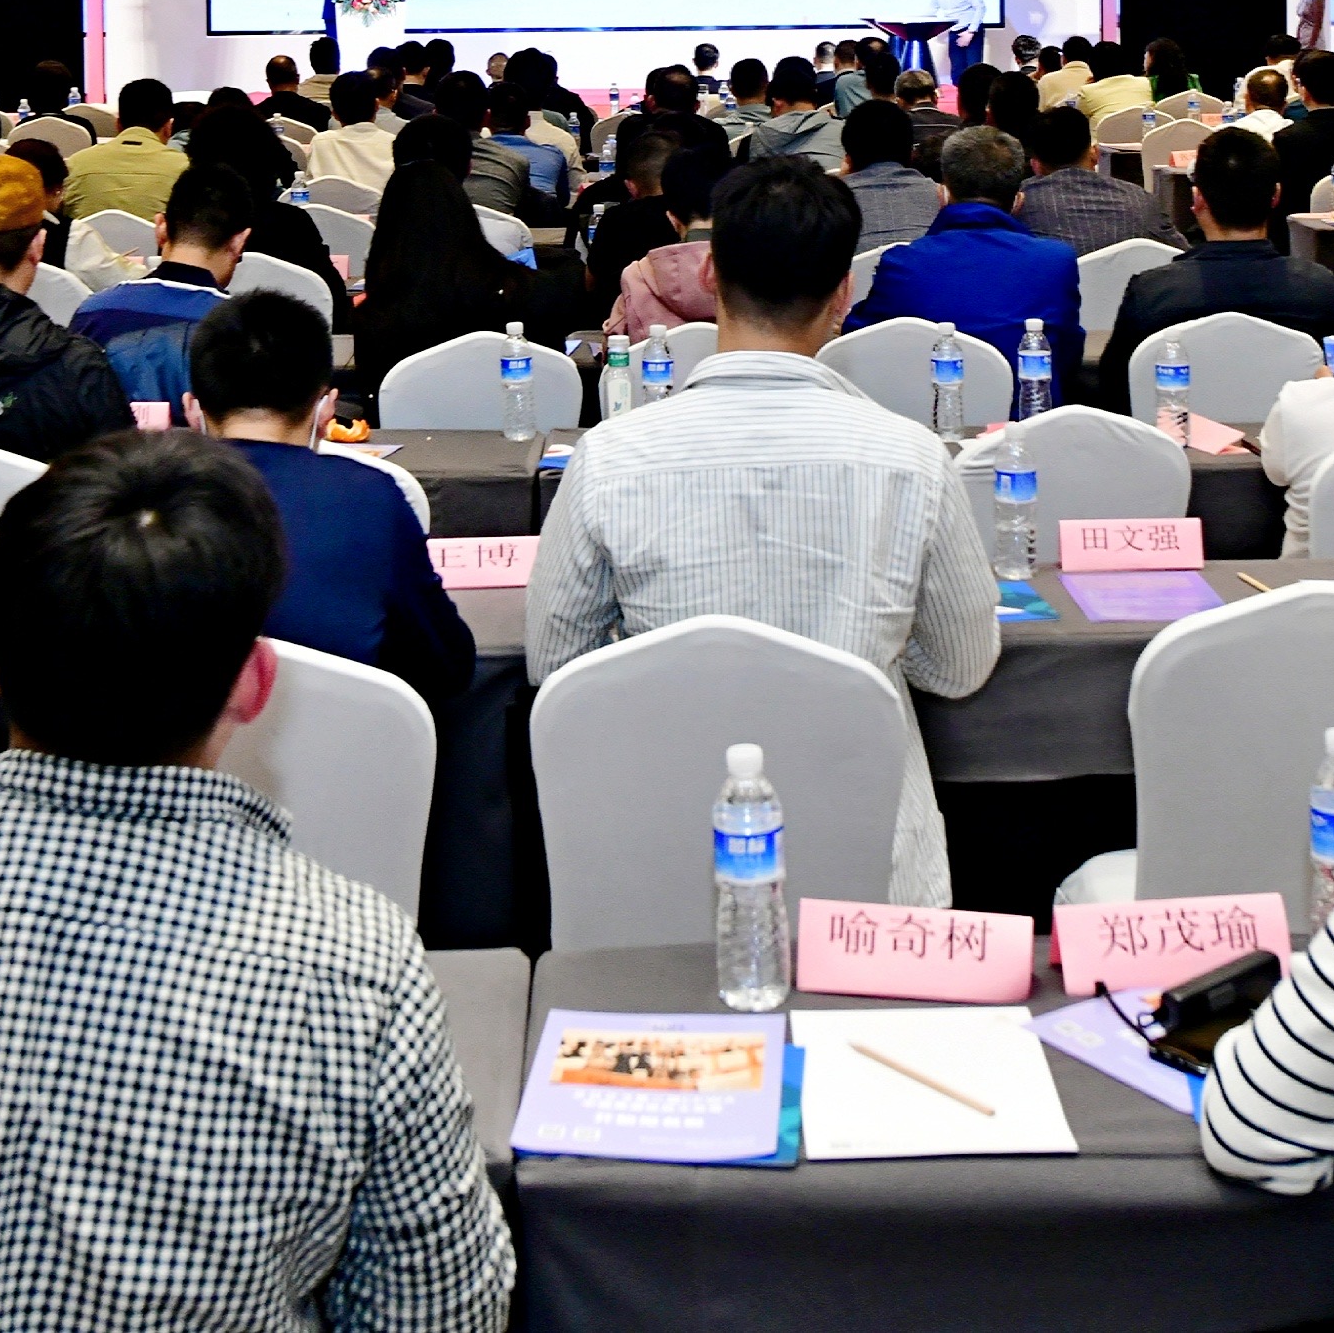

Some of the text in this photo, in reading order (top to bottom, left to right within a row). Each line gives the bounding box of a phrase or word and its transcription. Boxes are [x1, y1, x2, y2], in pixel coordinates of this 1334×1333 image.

[1081, 523, 1181, 552] 田文强
[829, 908, 993, 962] 喻奇树
[1098, 904, 1259, 957] 郑茂瑜
